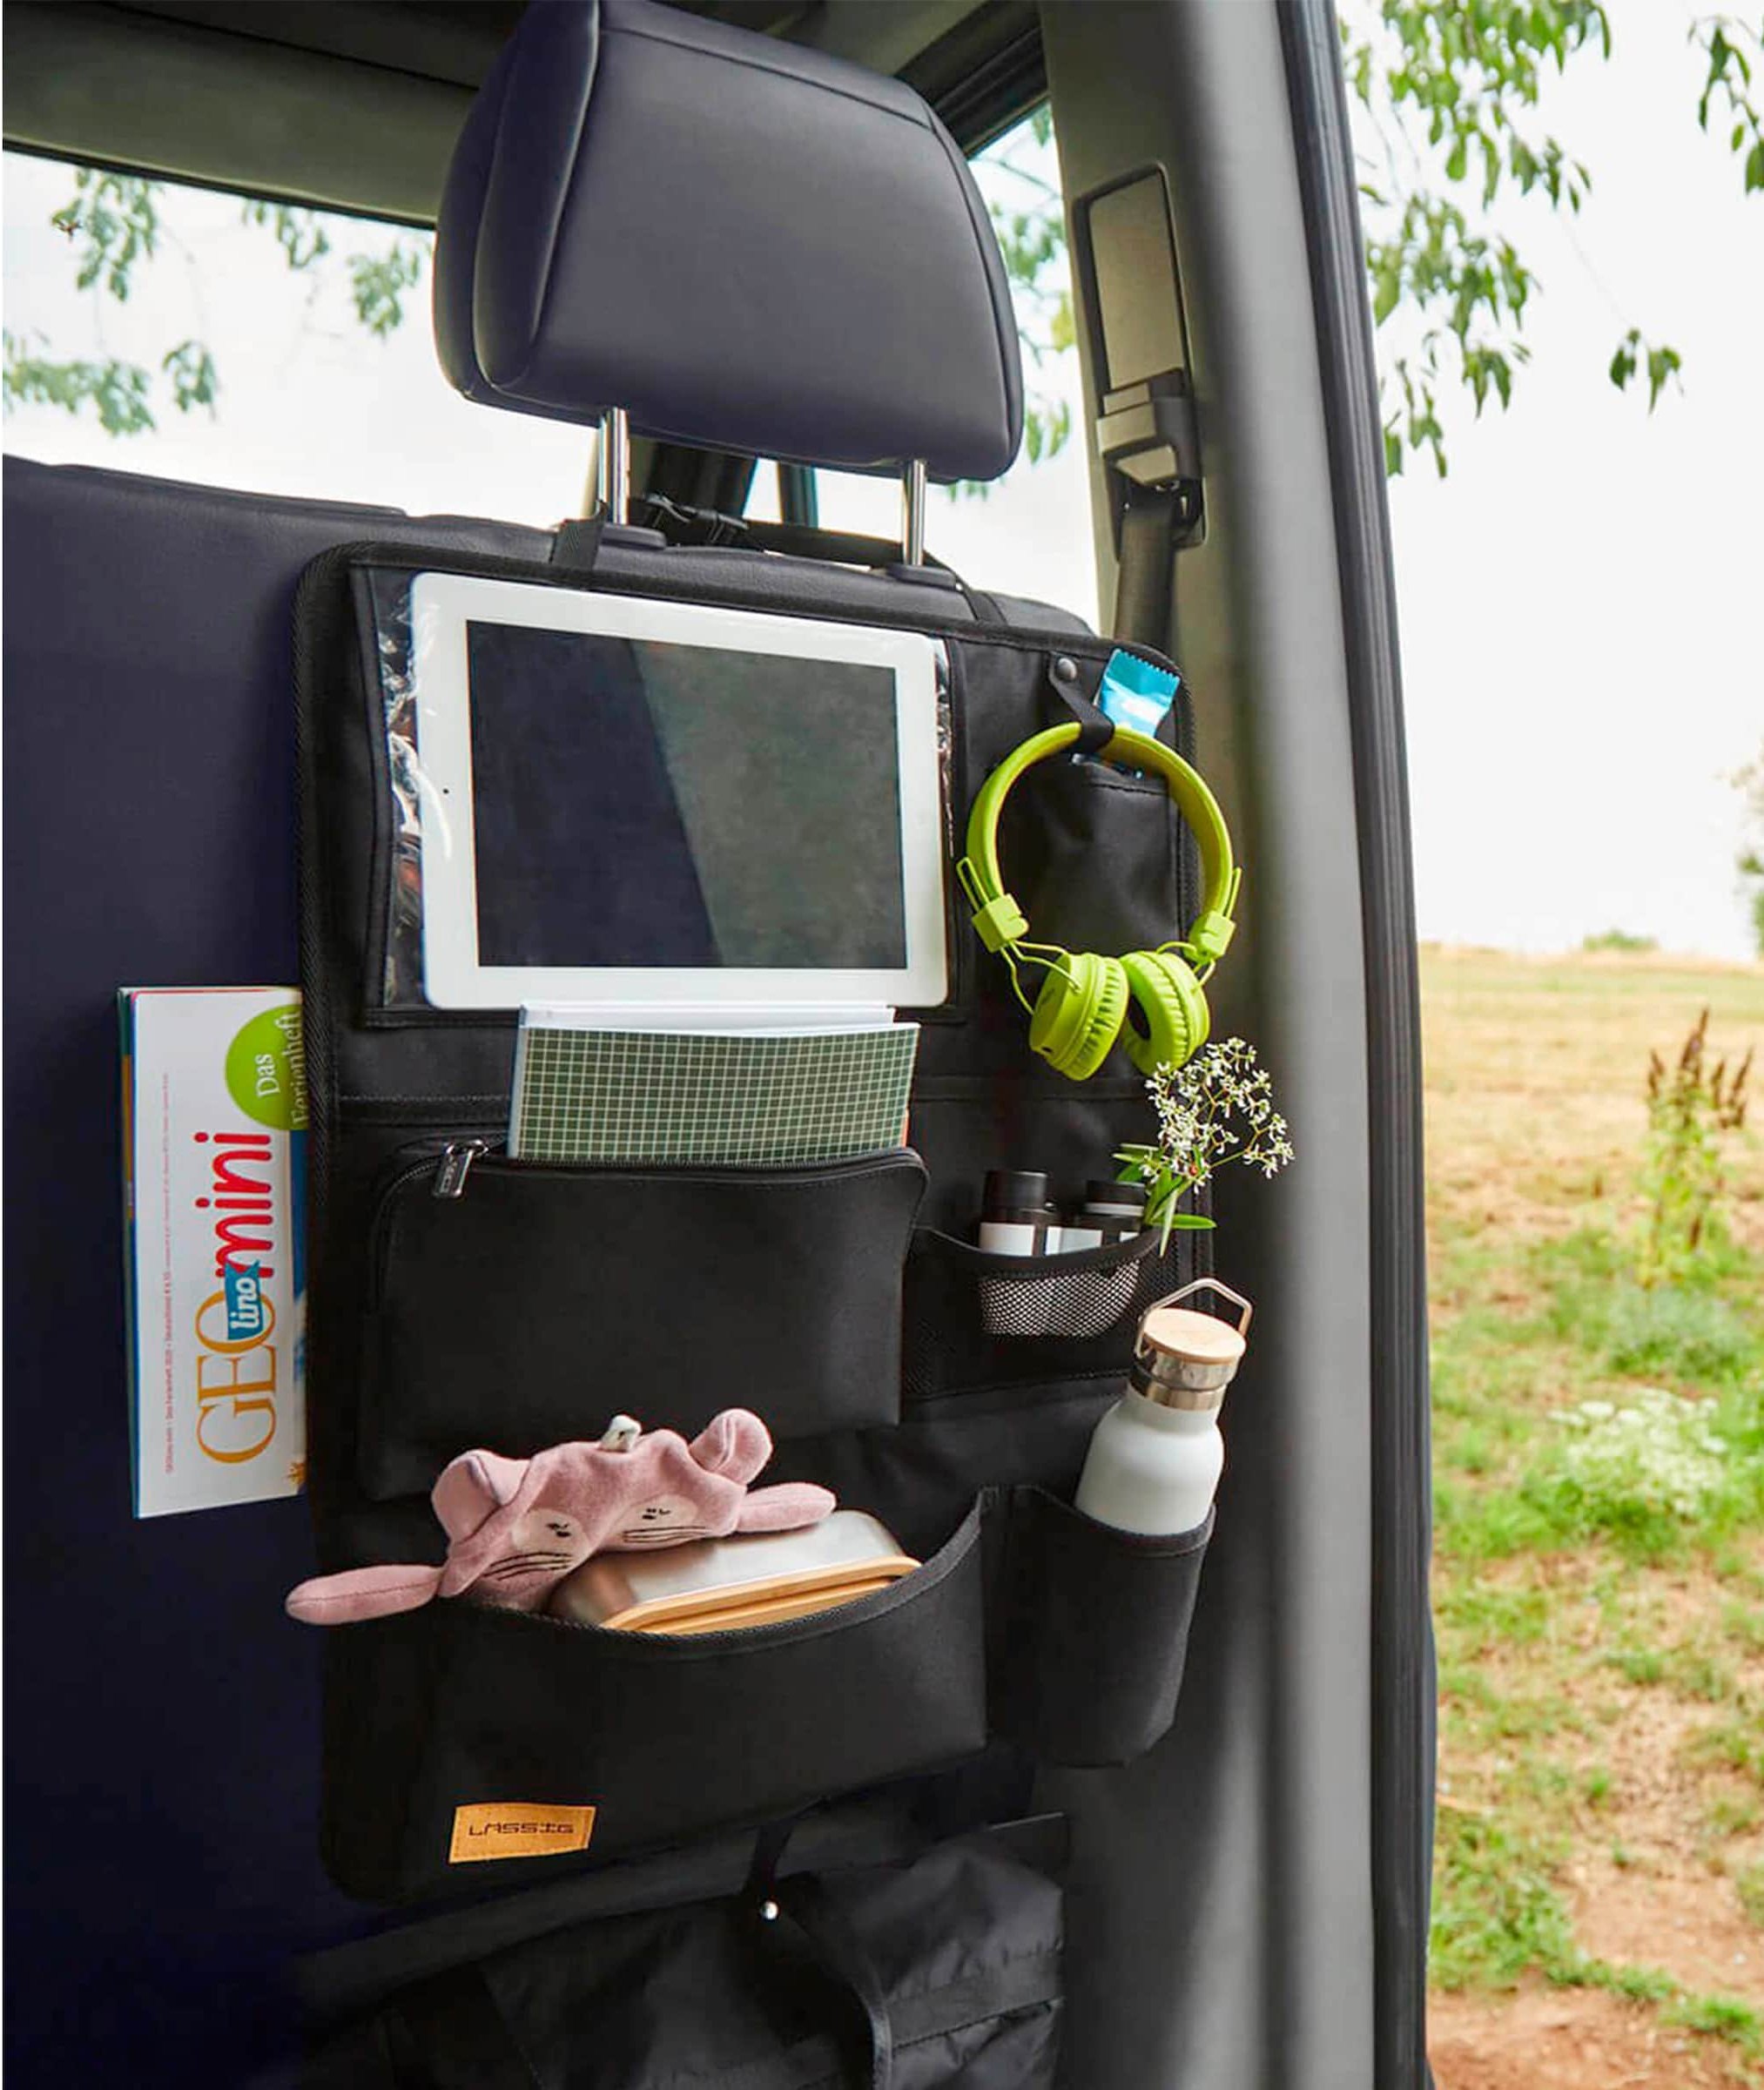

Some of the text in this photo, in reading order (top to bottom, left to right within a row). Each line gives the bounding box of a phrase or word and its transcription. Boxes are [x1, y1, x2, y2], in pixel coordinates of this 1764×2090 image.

[255, 1053, 281, 1097] Das
[194, 1132, 277, 1464] GEO lino mini
